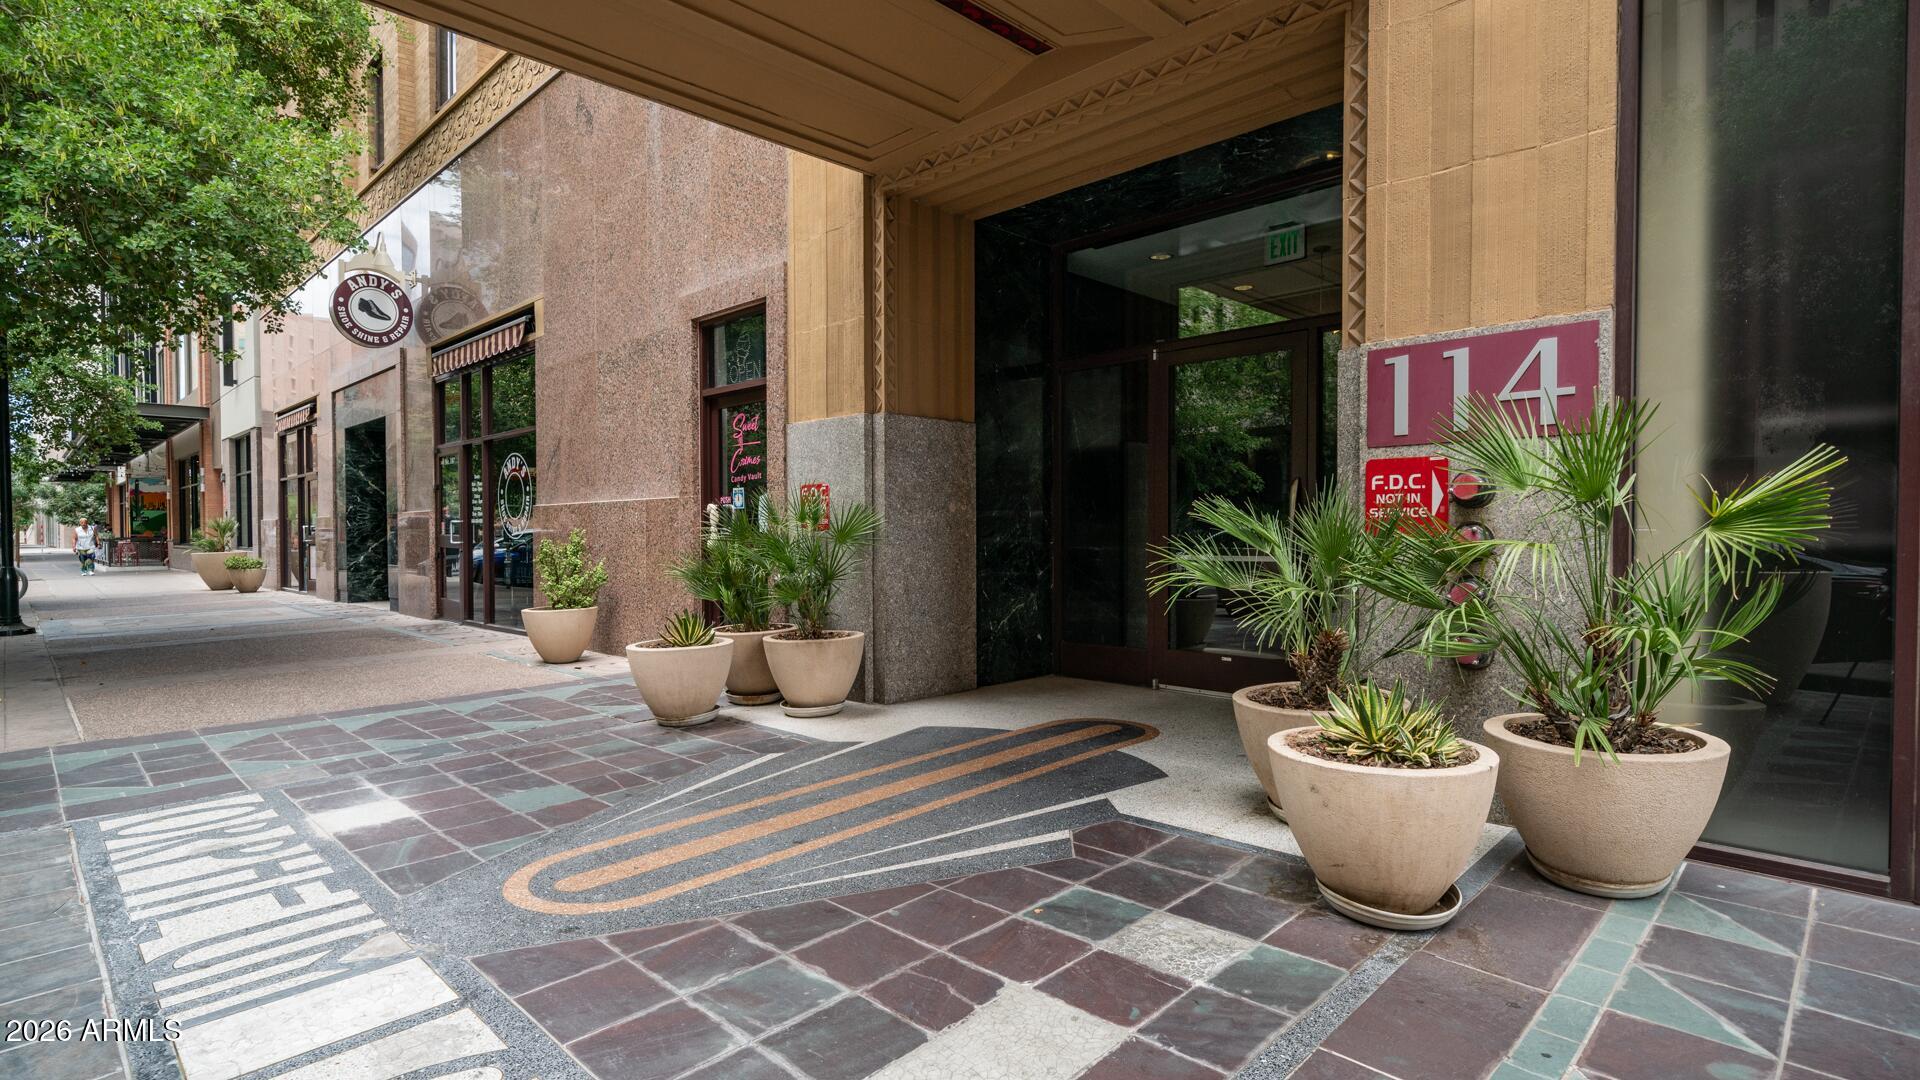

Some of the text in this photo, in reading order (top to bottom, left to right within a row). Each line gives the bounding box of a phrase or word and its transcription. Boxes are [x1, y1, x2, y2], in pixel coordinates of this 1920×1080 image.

[1269, 231, 1298, 259] EXIT
[347, 275, 403, 300] ANDY'S
[337, 306, 353, 329] SHOE
[351, 328, 380, 344] SHINE
[389, 315, 410, 341] REPAIR
[1384, 336, 1576, 436] 114
[732, 413, 760, 439] Sweet
[503, 456, 527, 480] ANDY'S
[1371, 473, 1426, 491] F.D.C.
[1375, 493, 1421, 504] NOT IN
